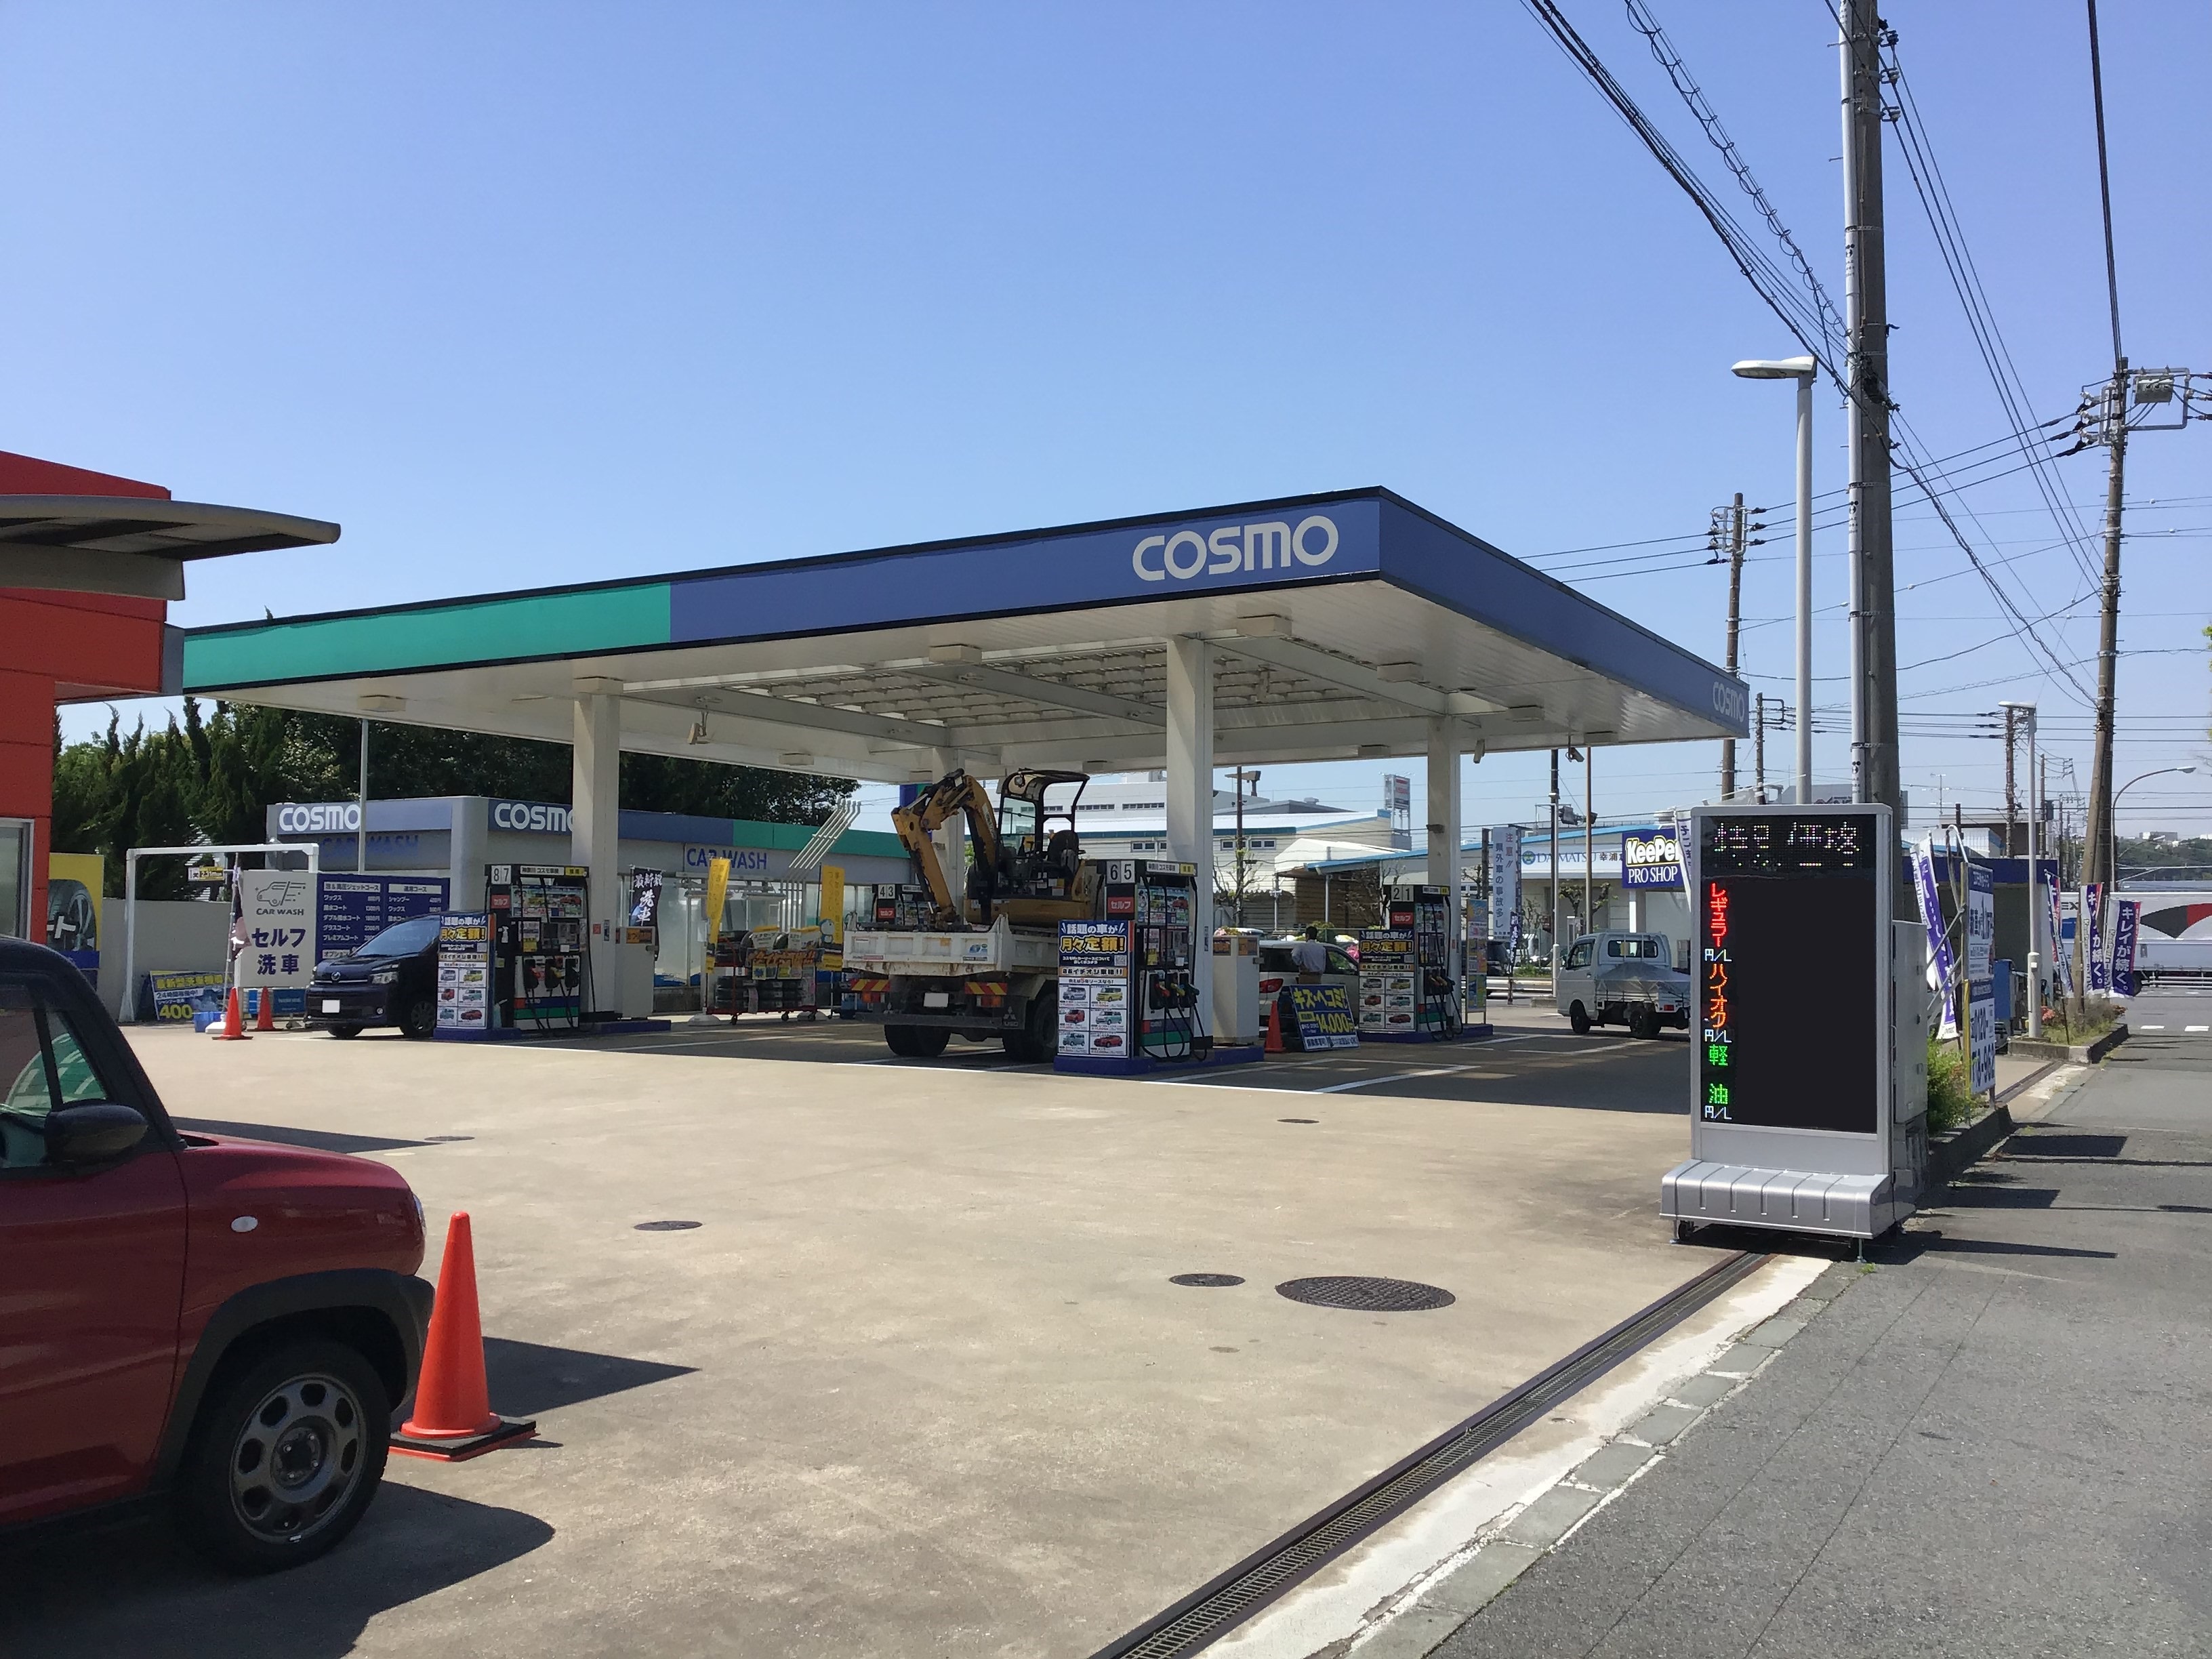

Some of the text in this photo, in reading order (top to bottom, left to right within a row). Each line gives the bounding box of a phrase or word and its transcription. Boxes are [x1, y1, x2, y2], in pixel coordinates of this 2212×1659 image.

[1132, 514, 1339, 581] COSMO
[1712, 680, 1746, 723] COSMO
[279, 804, 361, 832] COSMO
[722, 849, 767, 869] WASH
[1628, 865, 1678, 884] PRO SHOP
[1110, 901, 1131, 909] セルフ
[1710, 882, 1728, 947] レギュラー
[251, 927, 306, 948] セルフ
[1067, 924, 1118, 935] 話題の車が
[1061, 936, 1125, 951] 月々定額!
[1361, 941, 1412, 952] 月々定額!
[257, 954, 300, 975] 洗車
[1709, 963, 1728, 1028] ハイオク
